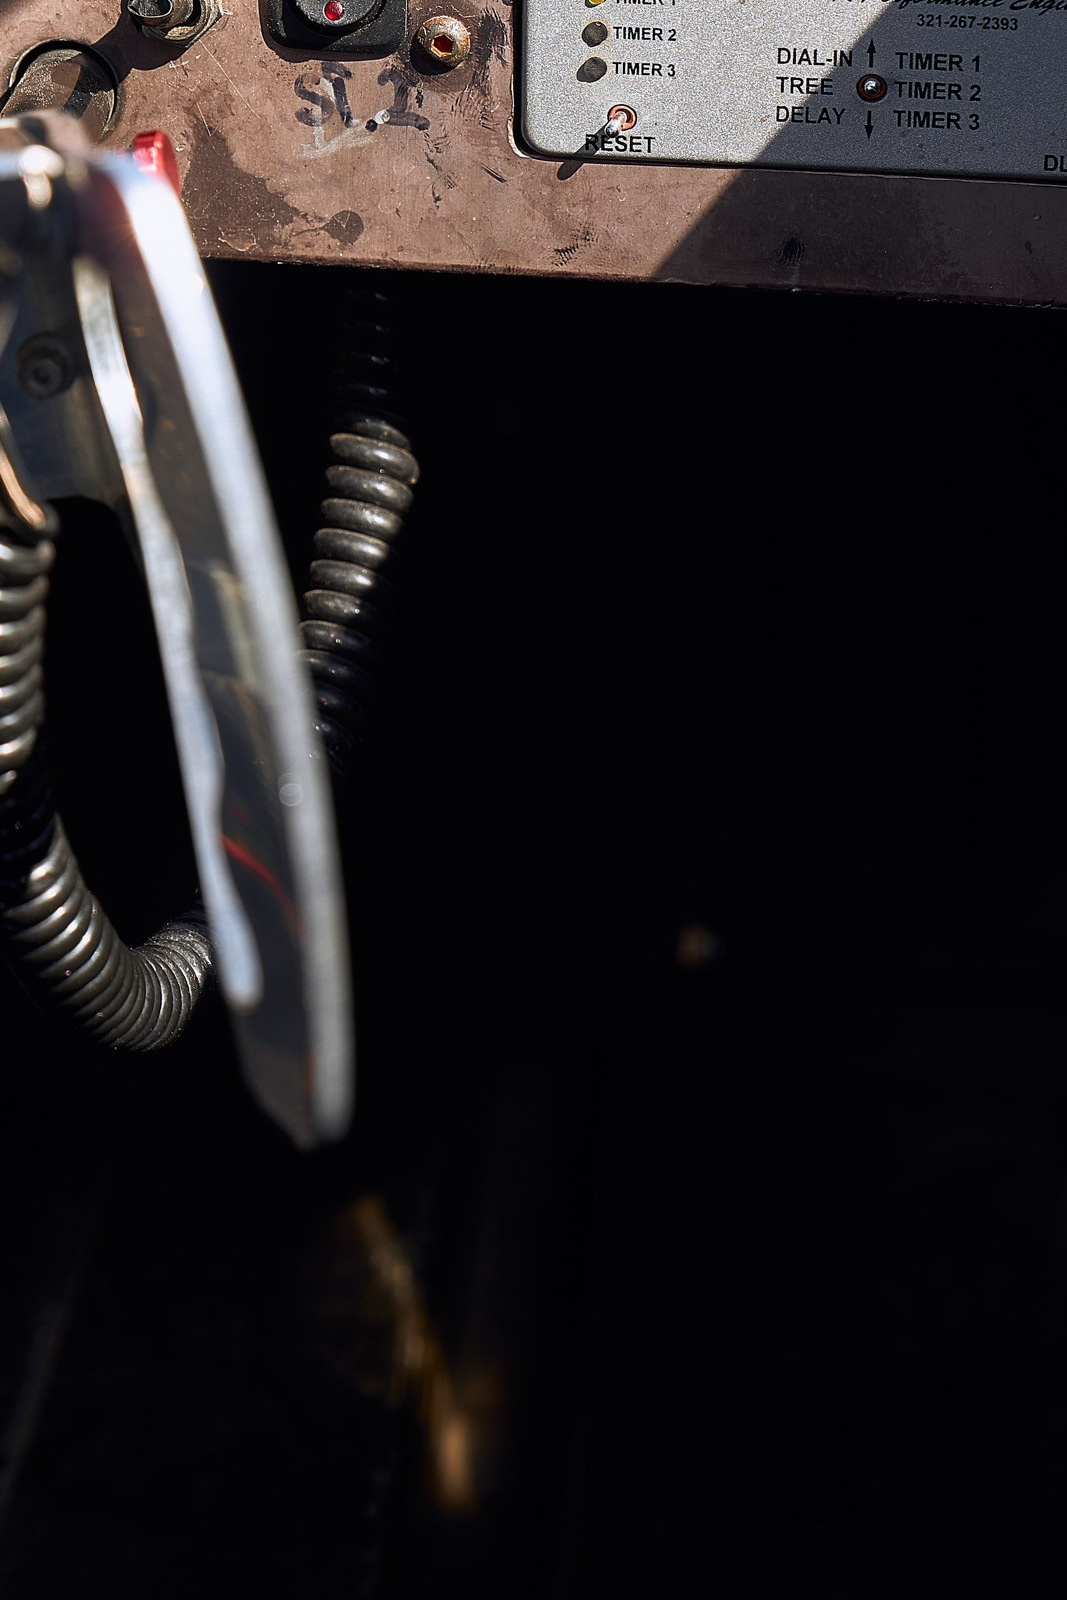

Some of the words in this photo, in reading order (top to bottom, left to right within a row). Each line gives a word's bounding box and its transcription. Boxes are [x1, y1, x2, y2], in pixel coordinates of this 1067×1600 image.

[916, 14, 1018, 31] 321-267-2393
[613, 26, 663, 41] TIMER
[668, 29, 677, 41] 2
[612, 62, 662, 77] TIMER
[667, 64, 676, 77] 3
[777, 47, 853, 67] DIAL-IN
[896, 52, 963, 71] TIMER
[971, 55, 981, 72] 1
[776, 77, 834, 95] TREE
[895, 81, 963, 100] TIMER
[969, 84, 982, 101] 2
[776, 105, 846, 125] DELAY
[893, 110, 962, 130] TIMER
[968, 113, 980, 130] 3
[585, 134, 656, 154] RESET
